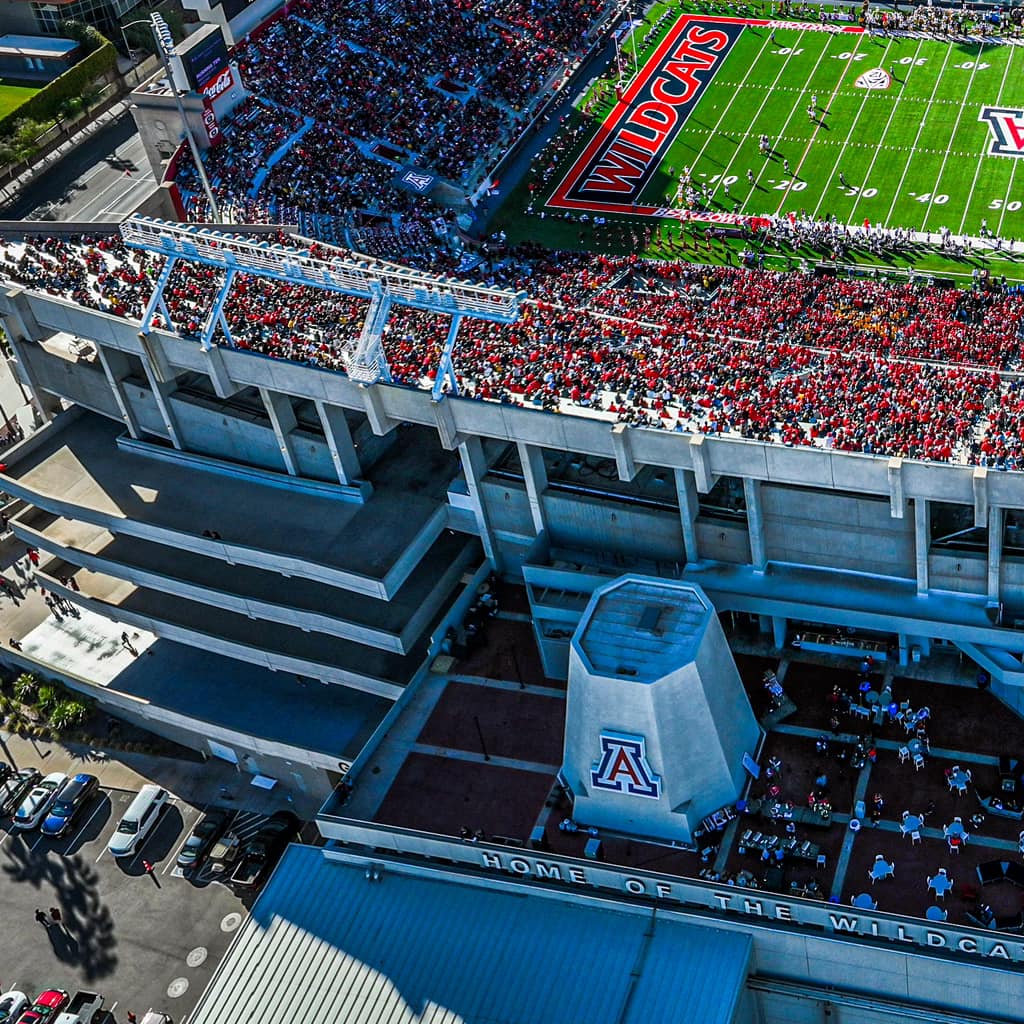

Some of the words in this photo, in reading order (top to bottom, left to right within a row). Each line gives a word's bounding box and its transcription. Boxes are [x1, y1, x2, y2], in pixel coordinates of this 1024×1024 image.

[778, 48, 804, 56] 10
[838, 52, 868, 61] 20
[899, 57, 929, 66] 30
[960, 61, 992, 71] 40
[577, 21, 730, 195] WILDCATS
[707, 174, 738, 186] 10
[772, 180, 808, 192] 20
[914, 192, 950, 205] 40
[988, 199, 1022, 211] 50
[590, 733, 661, 800] A
[481, 851, 587, 885] HOME
[624, 878, 672, 899] OF
[714, 894, 793, 921] THE
